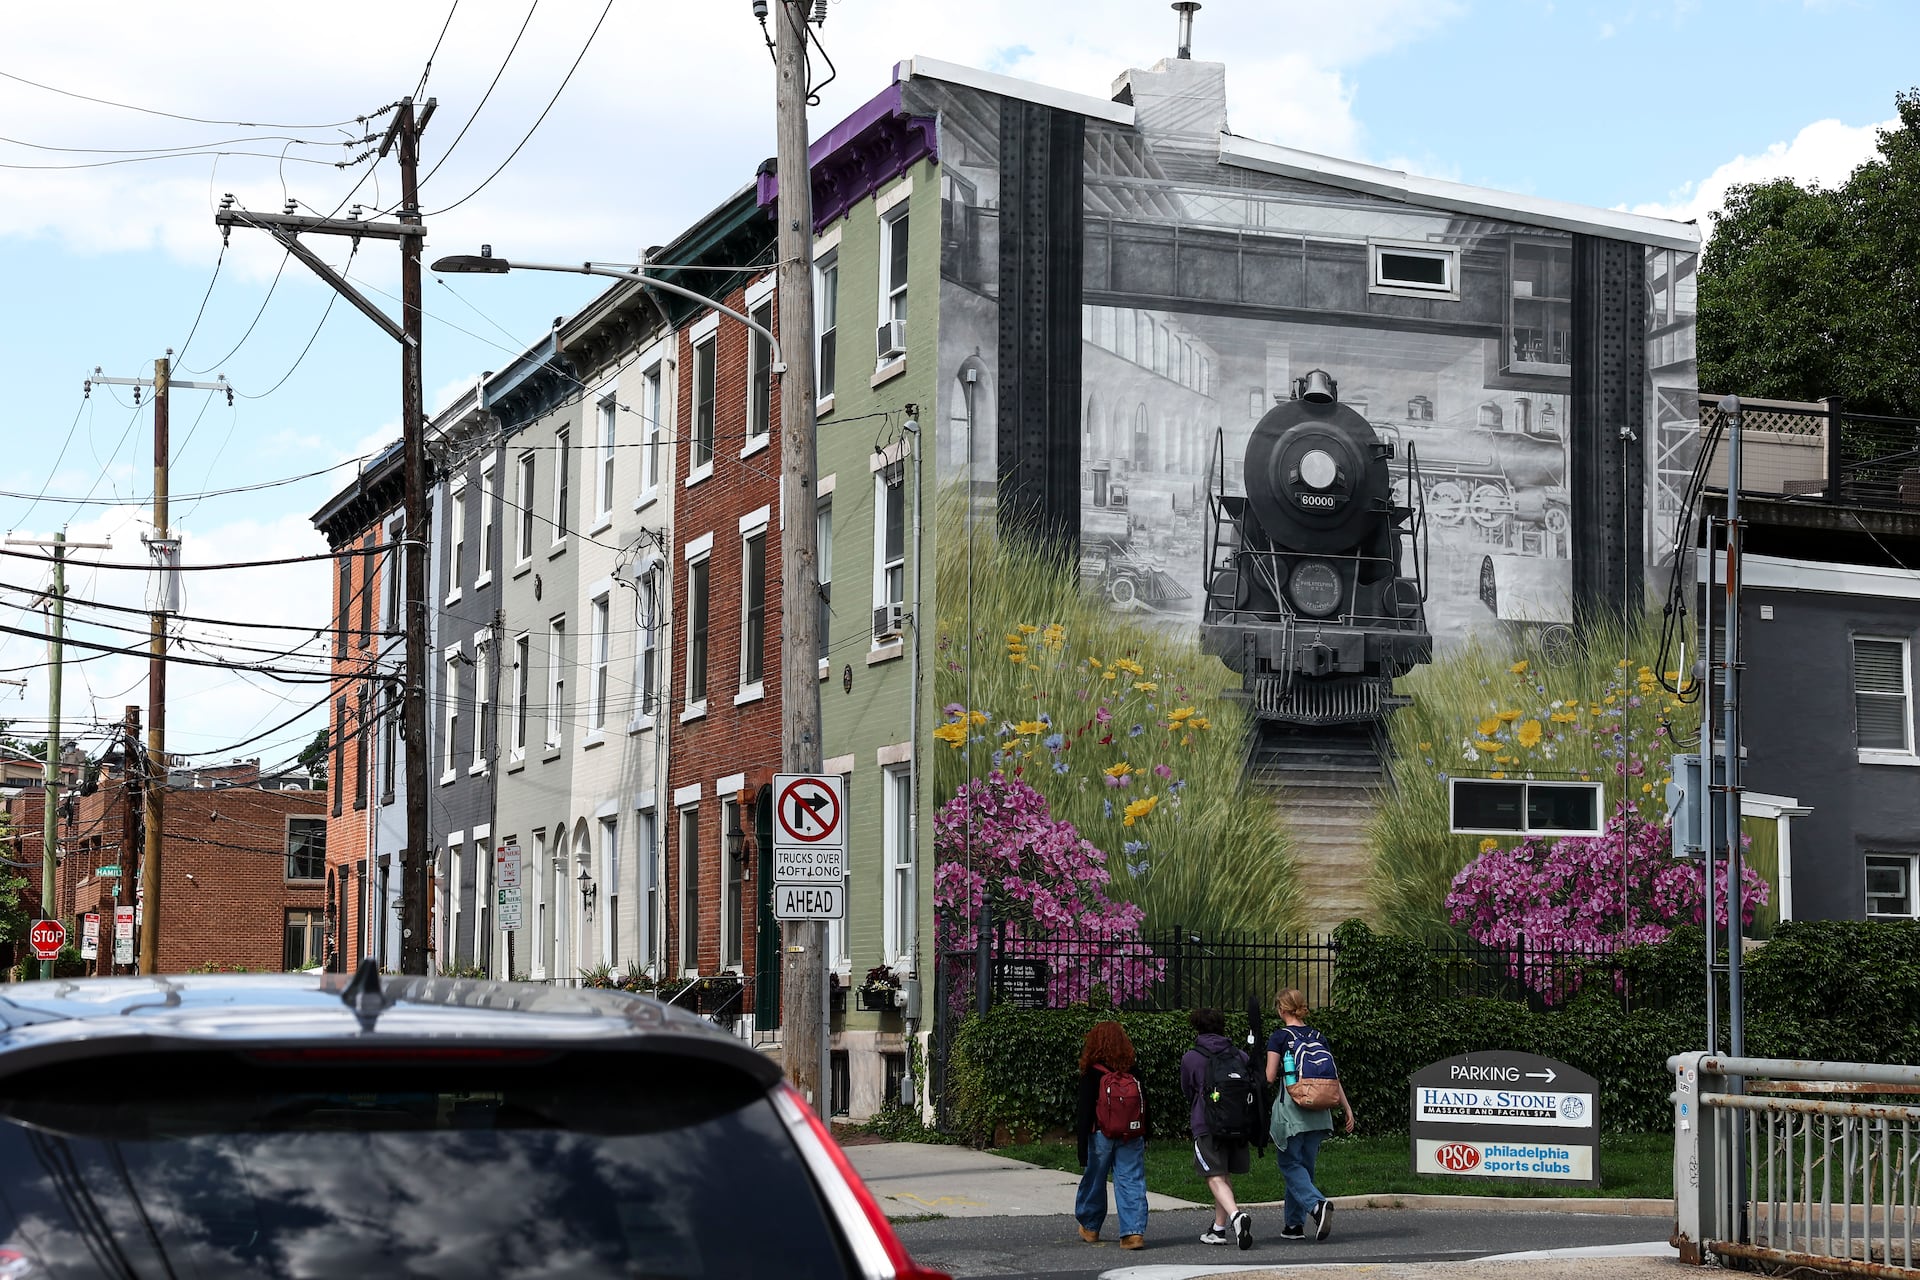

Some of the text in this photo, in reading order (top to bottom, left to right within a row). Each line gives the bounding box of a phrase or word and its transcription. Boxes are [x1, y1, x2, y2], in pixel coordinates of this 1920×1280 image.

[1302, 495, 1334, 507] 60000
[778, 853, 840, 864] TRUCKS OVER
[505, 862, 515, 870] ANY
[809, 866, 840, 877] LONG
[96, 869, 122, 877] HAMIL
[500, 890, 505, 903] 3
[785, 890, 833, 913] AHEAD
[33, 930, 63, 943] STOP
[1450, 1065, 1520, 1081] PARKING
[1424, 1090, 1557, 1109] HAND & STONE
[1497, 1109, 1531, 1117] FACIAL
[1534, 1110, 1551, 1118] SPA
[1441, 1145, 1475, 1169] PSC
[1485, 1146, 1569, 1160] philadelphia
[1484, 1160, 1570, 1173] sports clubs
